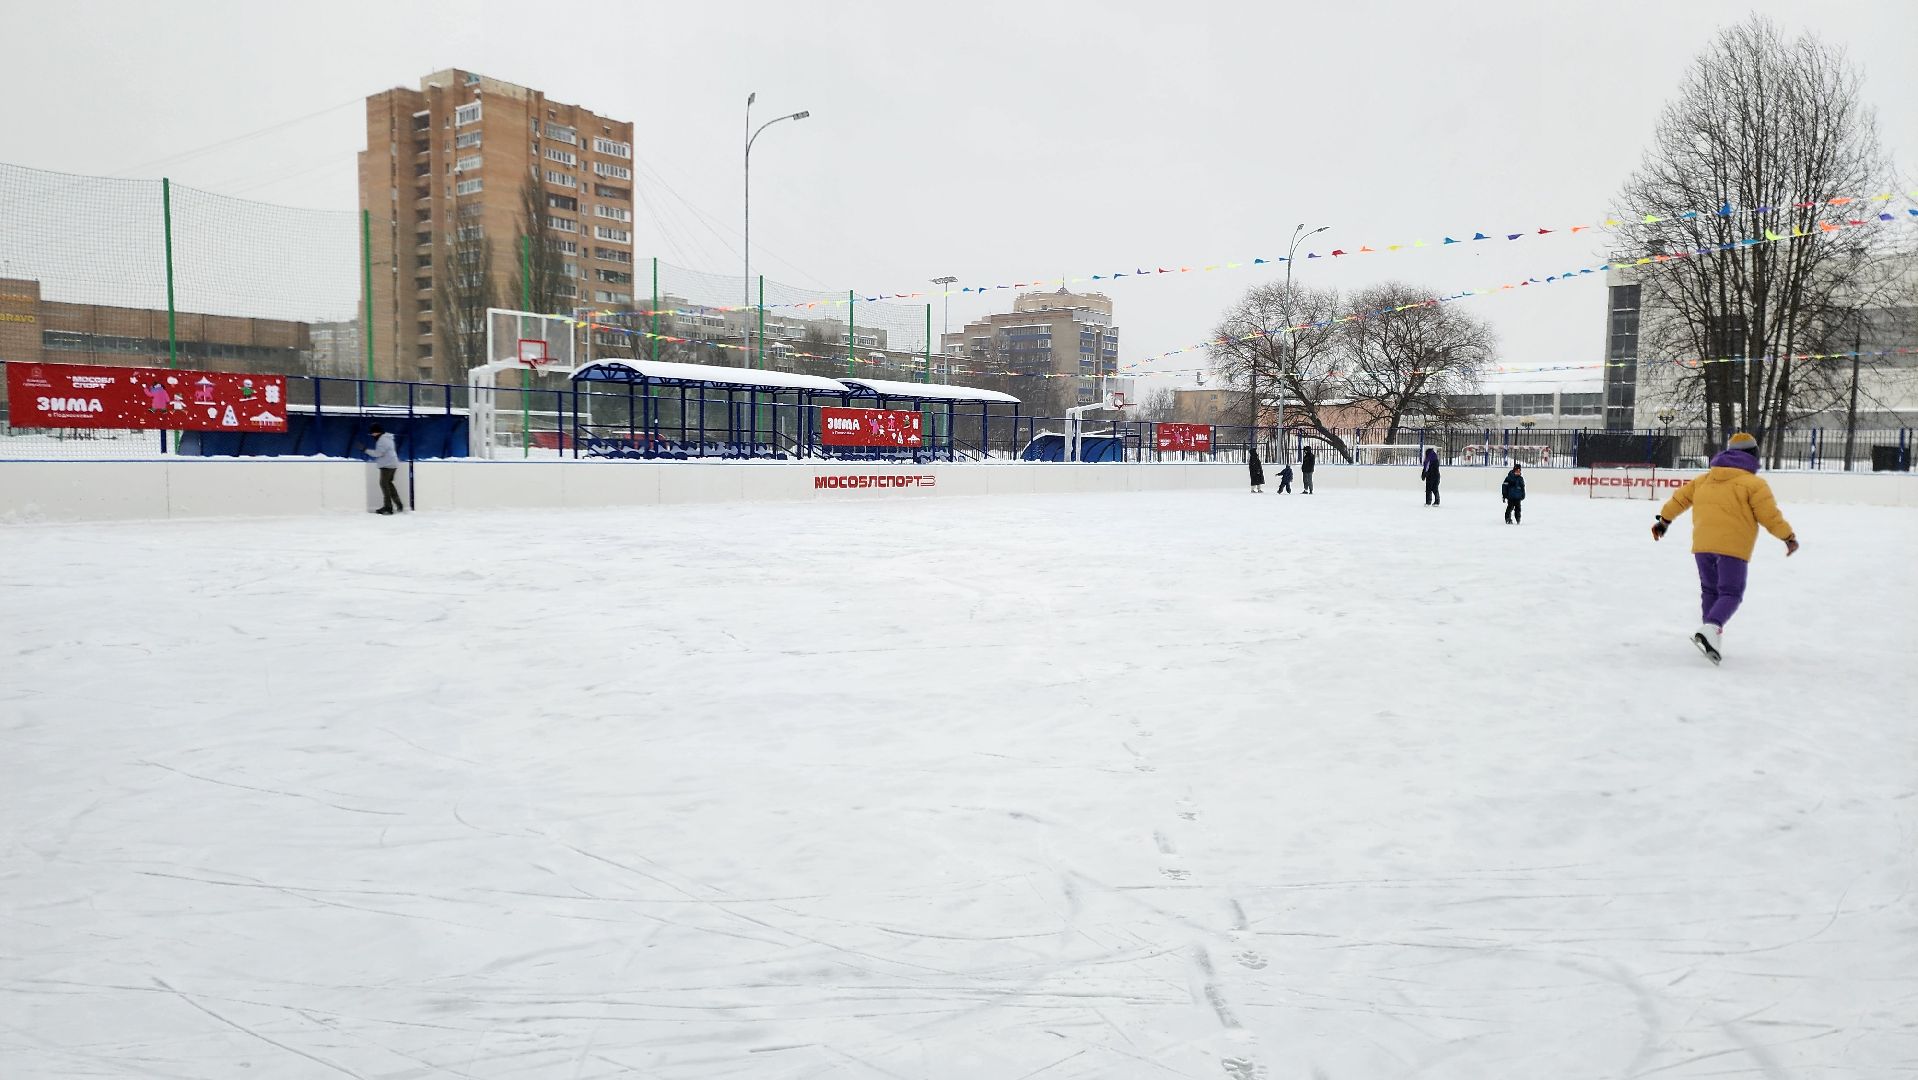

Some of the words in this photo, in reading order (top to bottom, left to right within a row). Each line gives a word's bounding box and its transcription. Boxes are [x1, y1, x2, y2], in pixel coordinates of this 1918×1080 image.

[72, 375, 115, 383] МОСОБЛ
[36, 396, 104, 412] ЗИМА
[827, 417, 861, 431] ЗИМА
[814, 475, 923, 489] МОСОБЛСПОРТ
[1573, 476, 1692, 488] МОСОБЛСПОР
